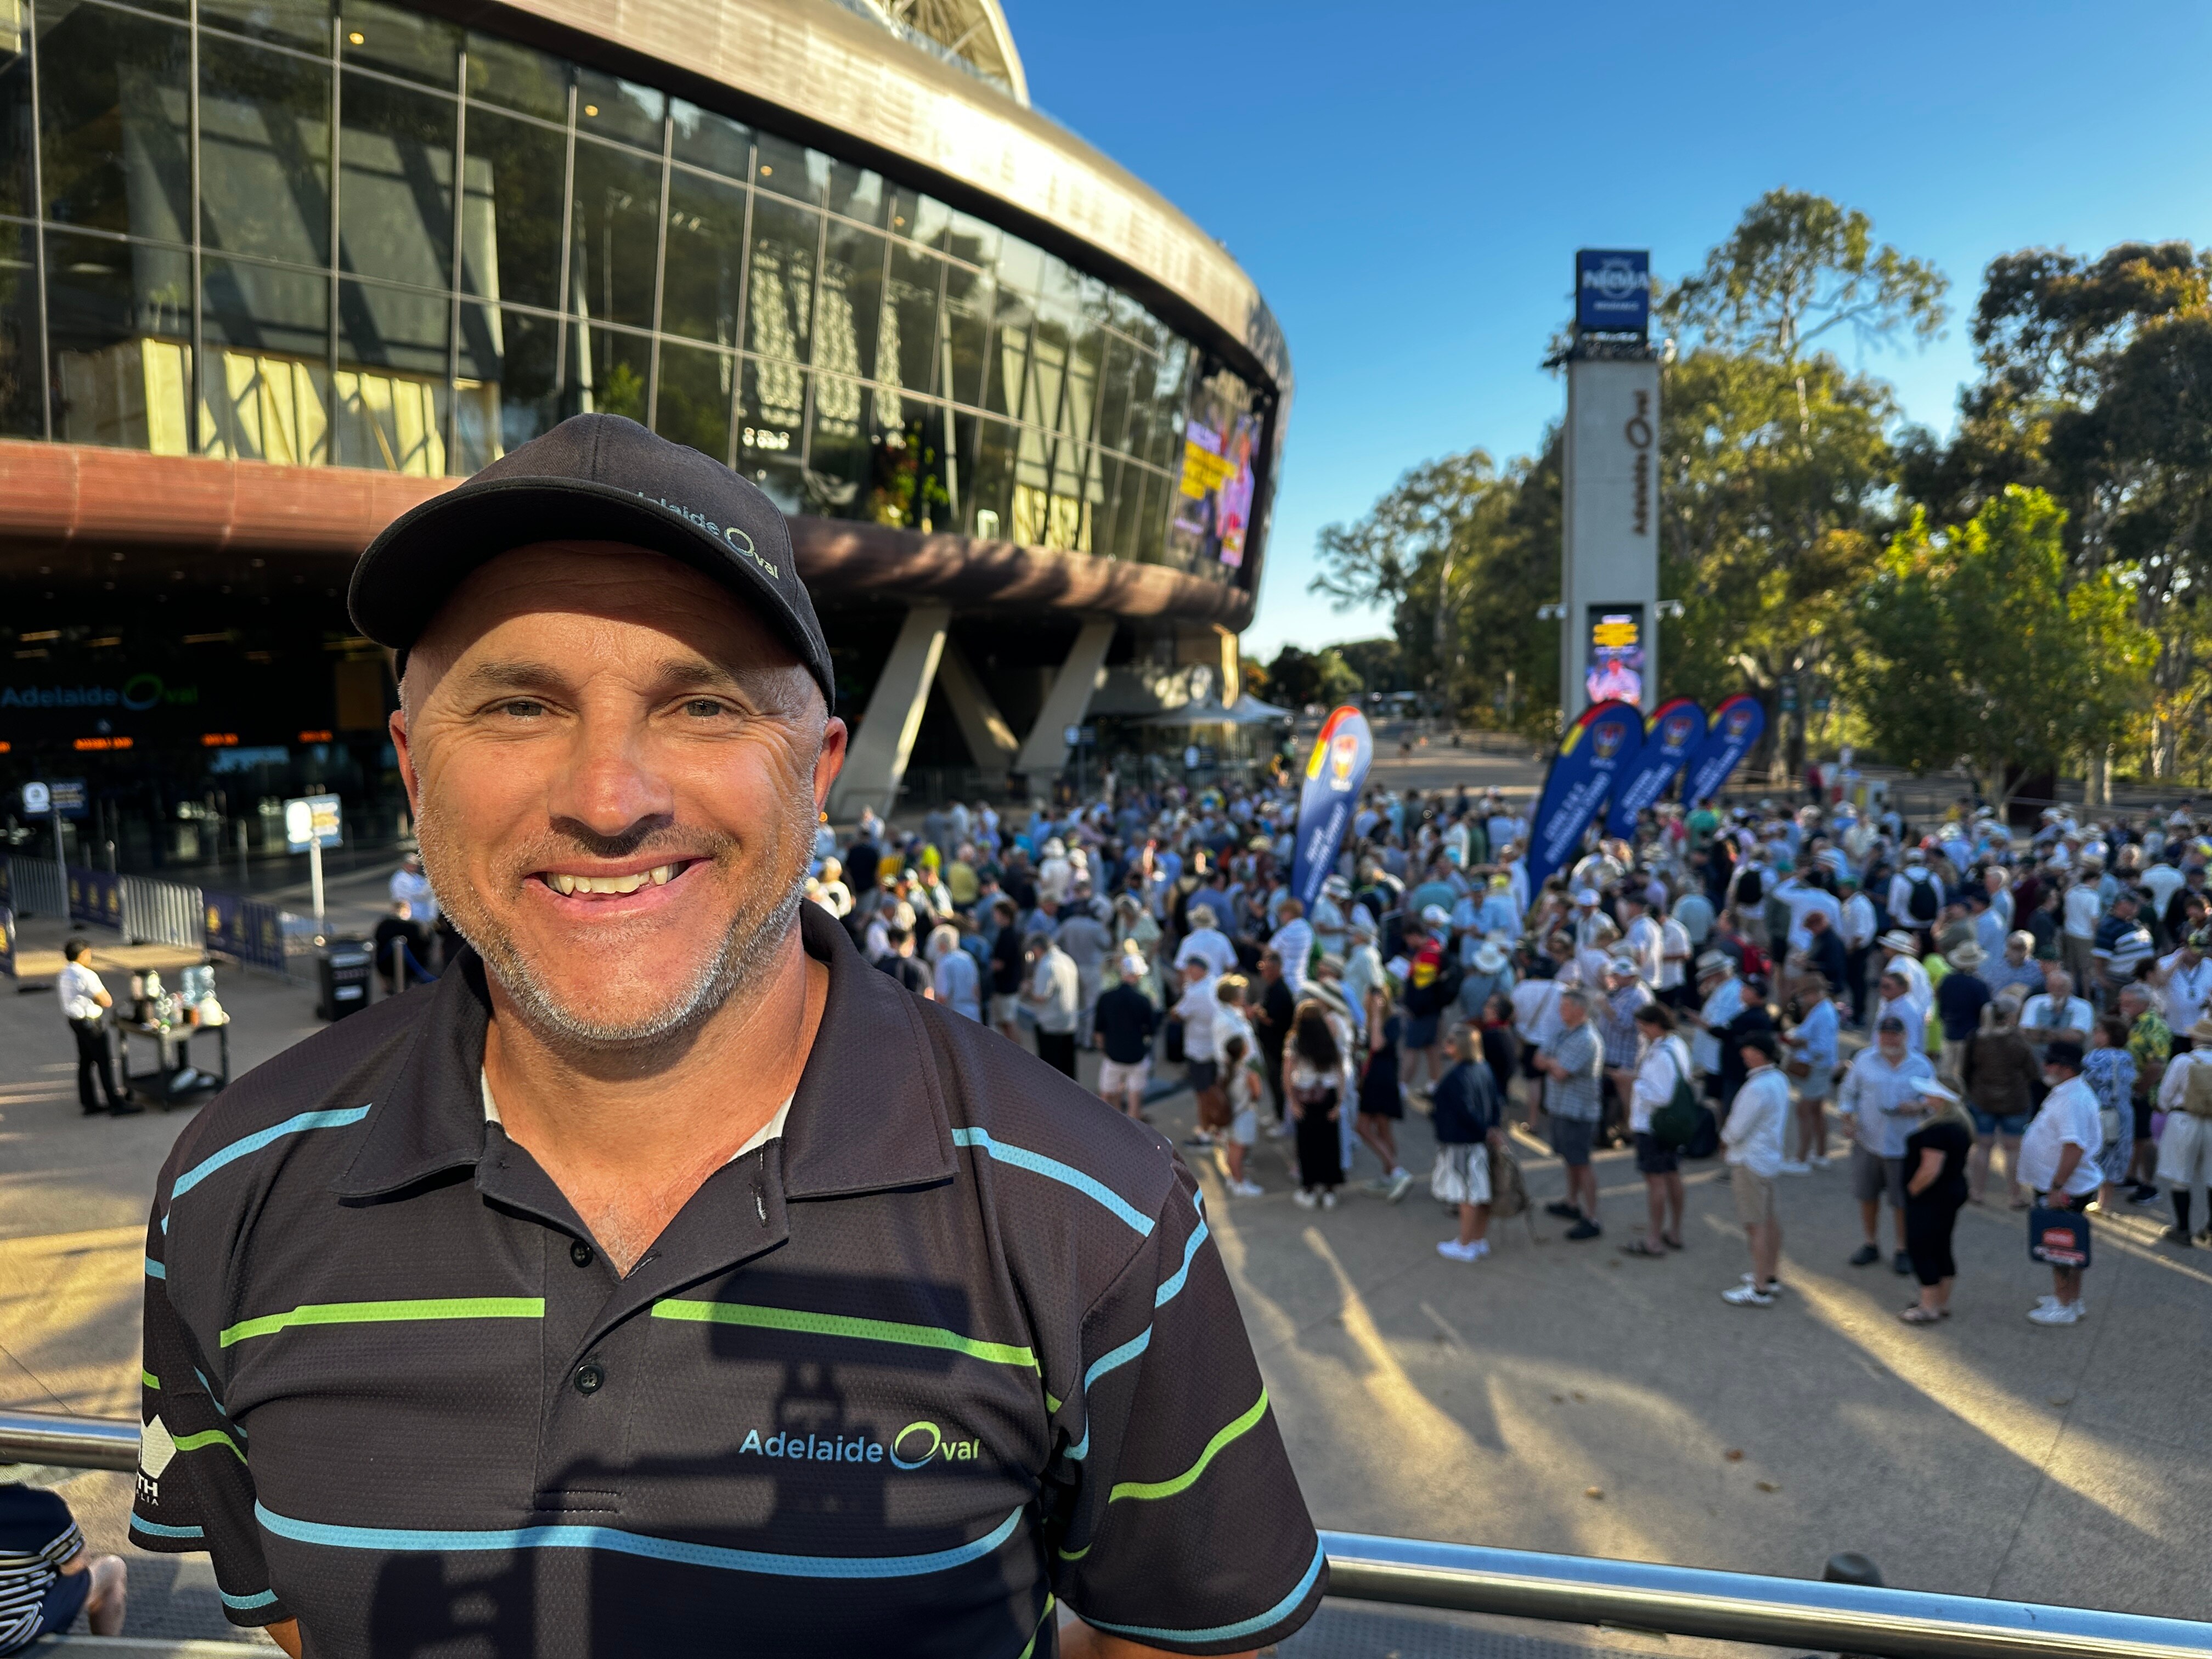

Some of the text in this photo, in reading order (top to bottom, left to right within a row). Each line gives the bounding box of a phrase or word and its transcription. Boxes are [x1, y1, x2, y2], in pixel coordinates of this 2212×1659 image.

[724, 527, 779, 580] Oval
[1, 673, 198, 710] Adelaide Oval
[738, 1421, 980, 1470] Adelaide Oval
